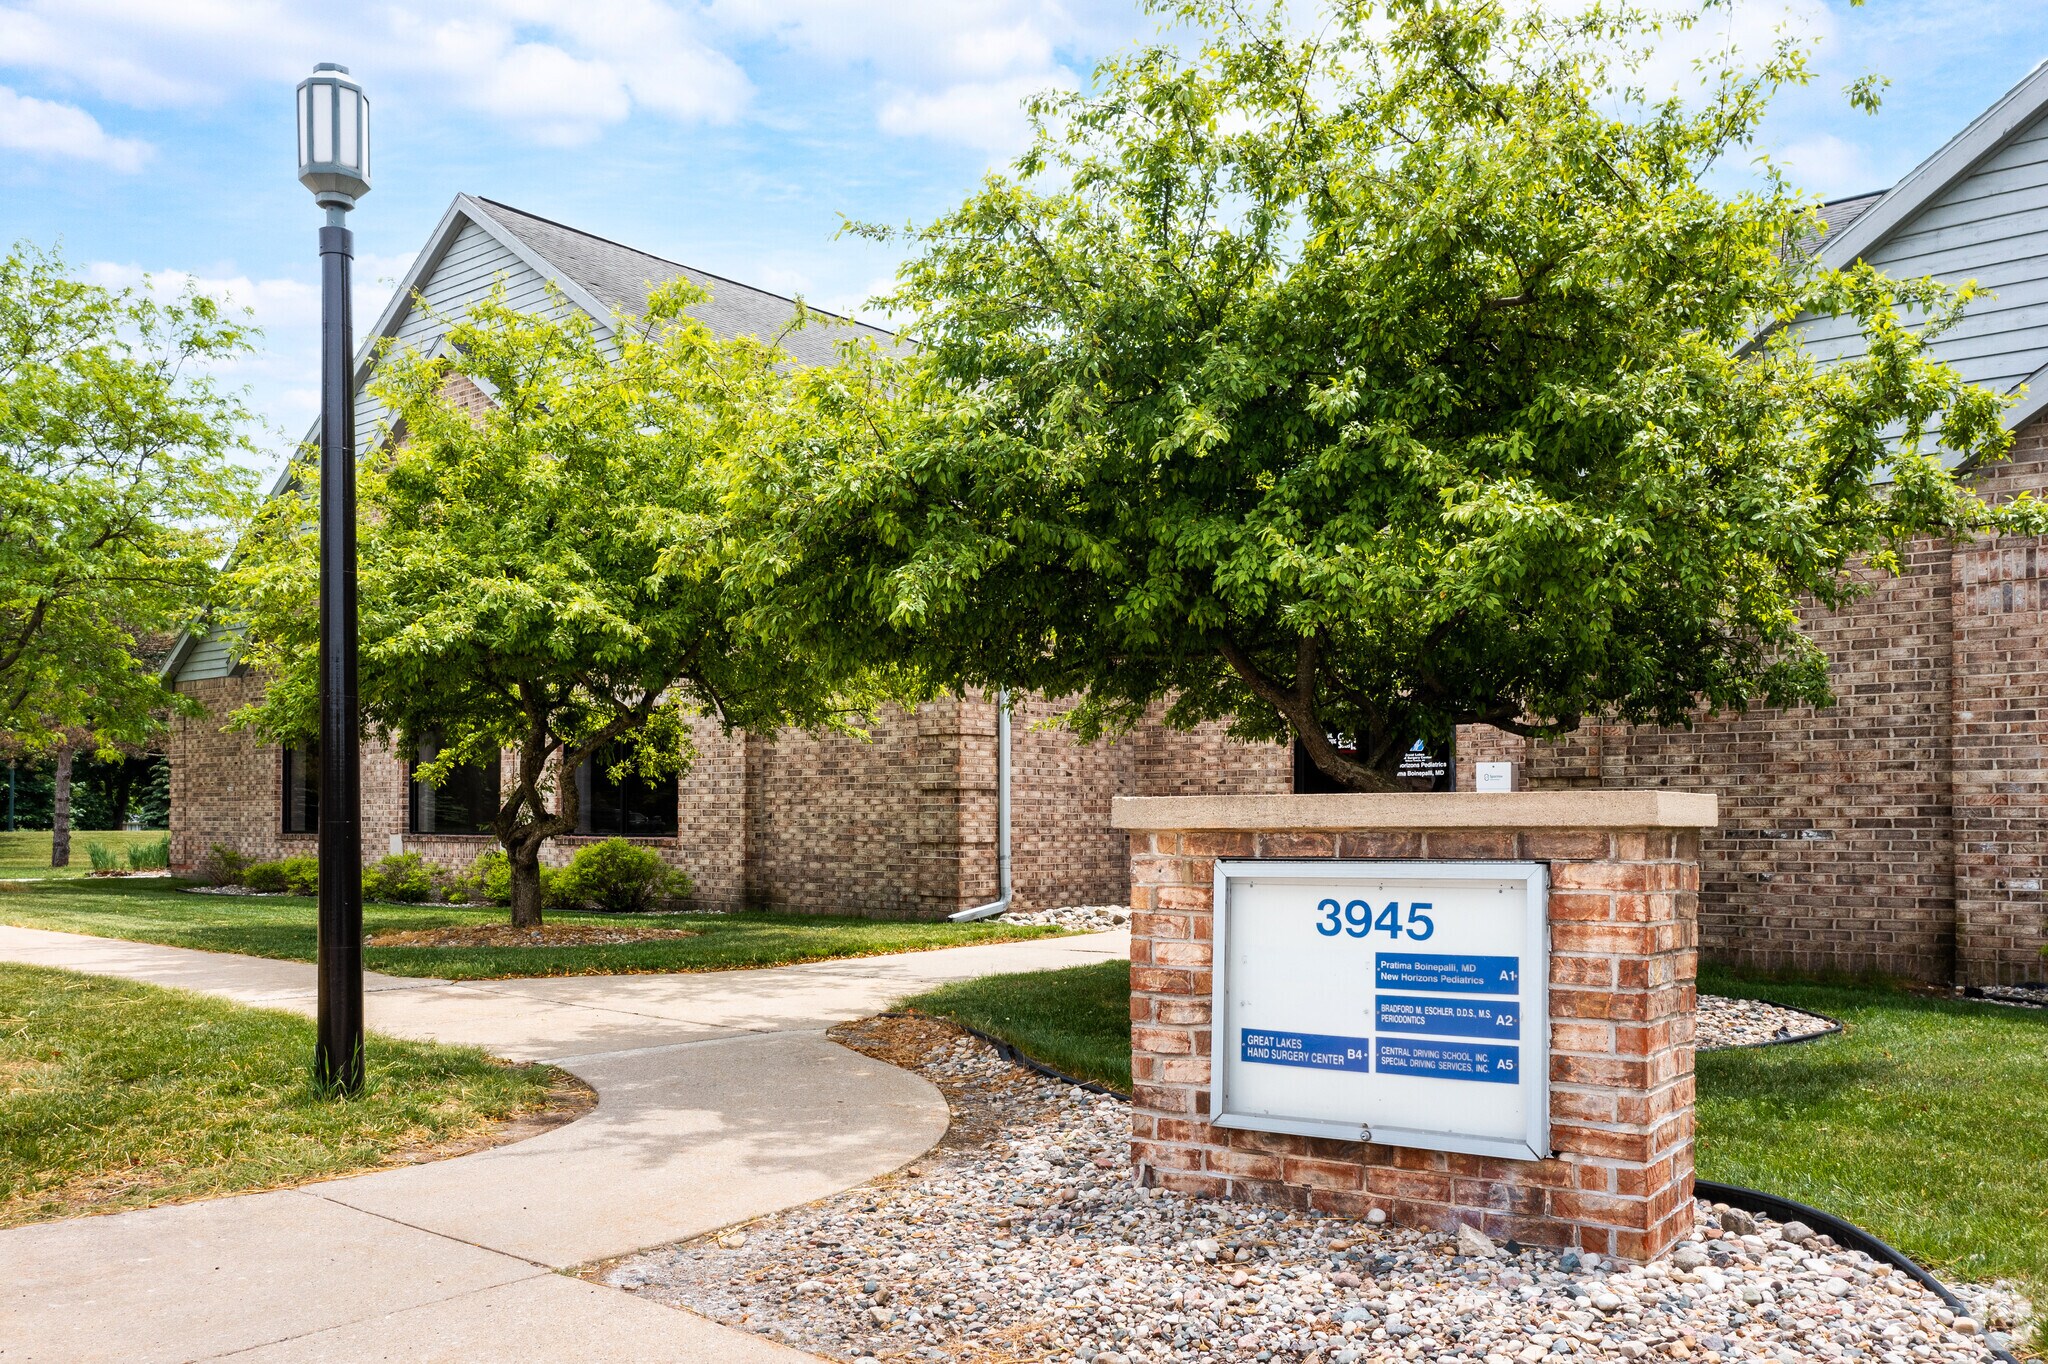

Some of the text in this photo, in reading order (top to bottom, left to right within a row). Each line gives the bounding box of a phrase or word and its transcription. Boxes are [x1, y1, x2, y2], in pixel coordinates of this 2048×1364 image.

[1316, 898, 1434, 941] 3945
[1380, 960, 1477, 973] Pratima Boinepalli, MD
[1380, 972, 1484, 985] New Horizons Pediatrics
[1499, 970, 1515, 981] A1
[1381, 1004, 1414, 1014] BRADFORD
[1415, 1006, 1423, 1015] M.
[1424, 1007, 1455, 1017] ESCHLER,
[1478, 1010, 1492, 1019] M.S.
[1381, 1014, 1426, 1025] PERIODONTICS
[1495, 1015, 1513, 1026] A2
[1247, 1034, 1302, 1049] GREAT LAKES
[1247, 1047, 1344, 1065] HAND SURGERY CENTER
[1347, 1048, 1362, 1060] B4
[1381, 1046, 1411, 1057] CENTRAL
[1413, 1049, 1440, 1059] DRIVING
[1475, 1053, 1490, 1062] INC.
[1381, 1056, 1490, 1073] SPECIAL DRIVING SERVICES, INC.
[1497, 1059, 1513, 1070] A5
